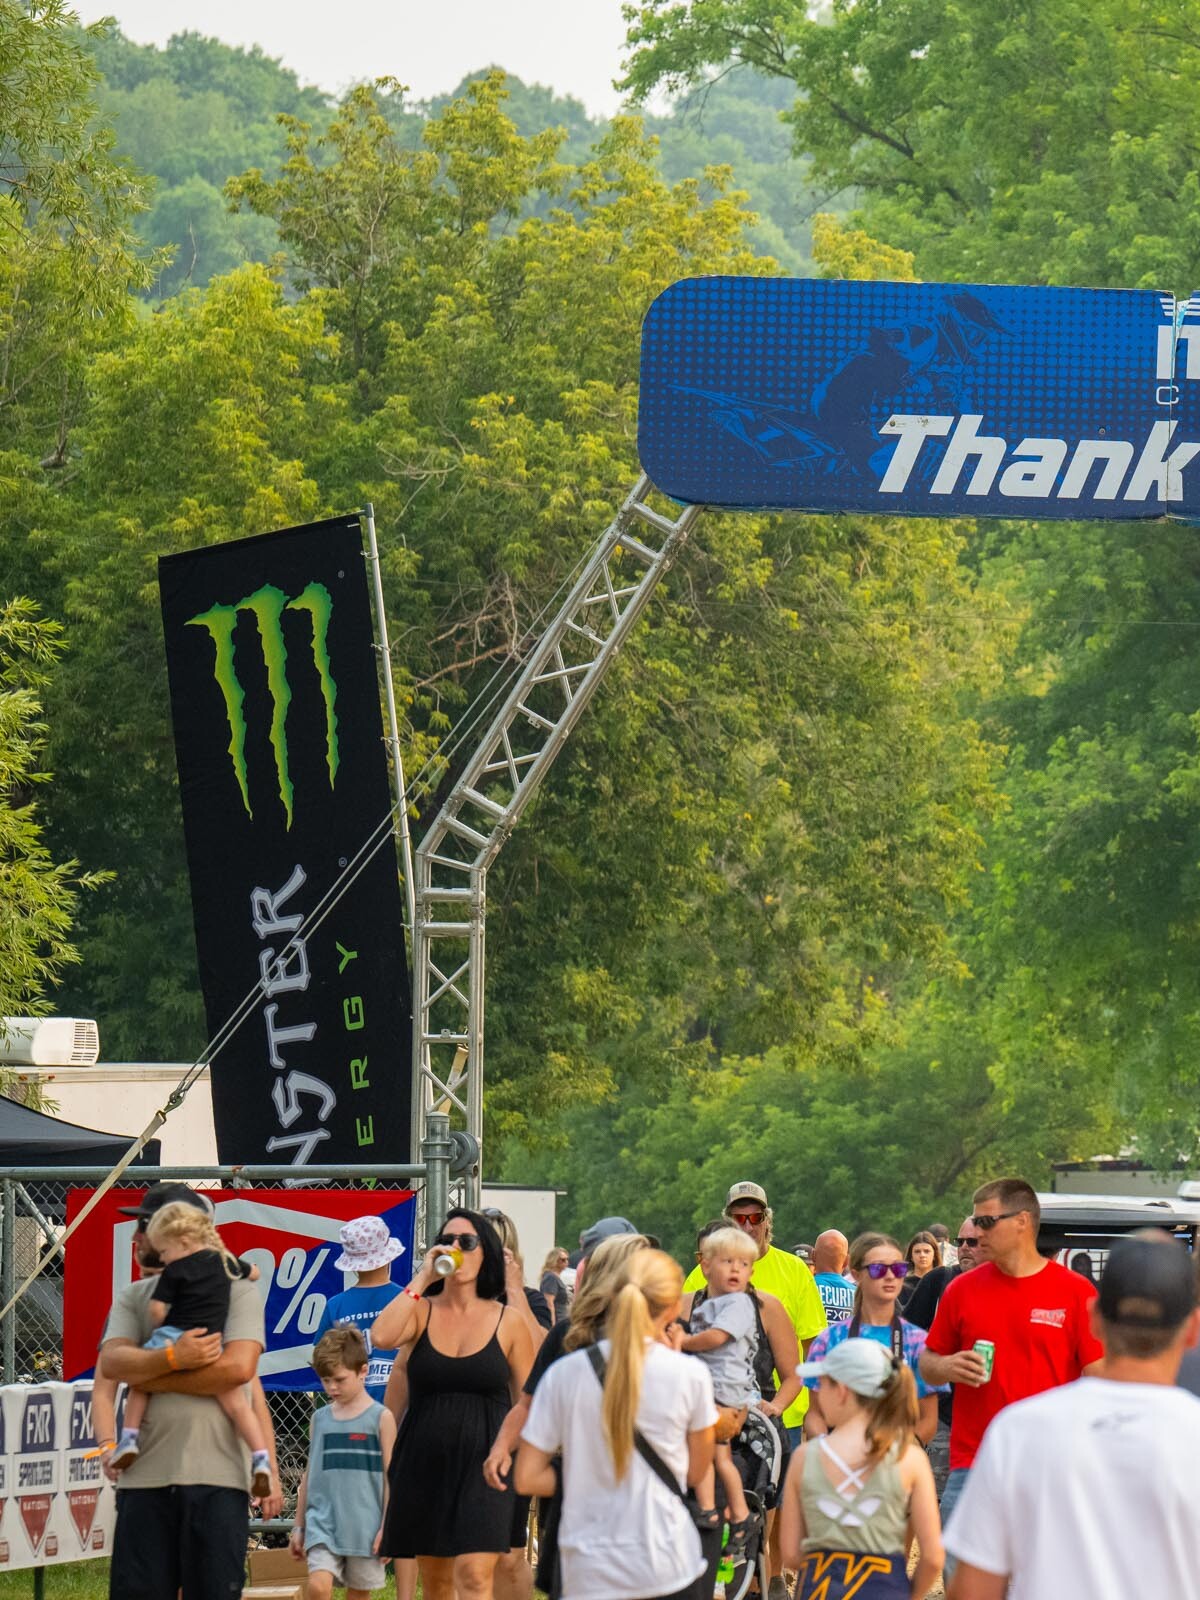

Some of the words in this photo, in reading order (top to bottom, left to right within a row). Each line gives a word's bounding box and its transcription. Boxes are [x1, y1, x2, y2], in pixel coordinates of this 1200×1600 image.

[250, 863, 337, 1189] NSTER
[818, 1284, 856, 1307] ECURIT
[26, 1403, 51, 1444] FXR
[72, 1400, 94, 1441] FX
